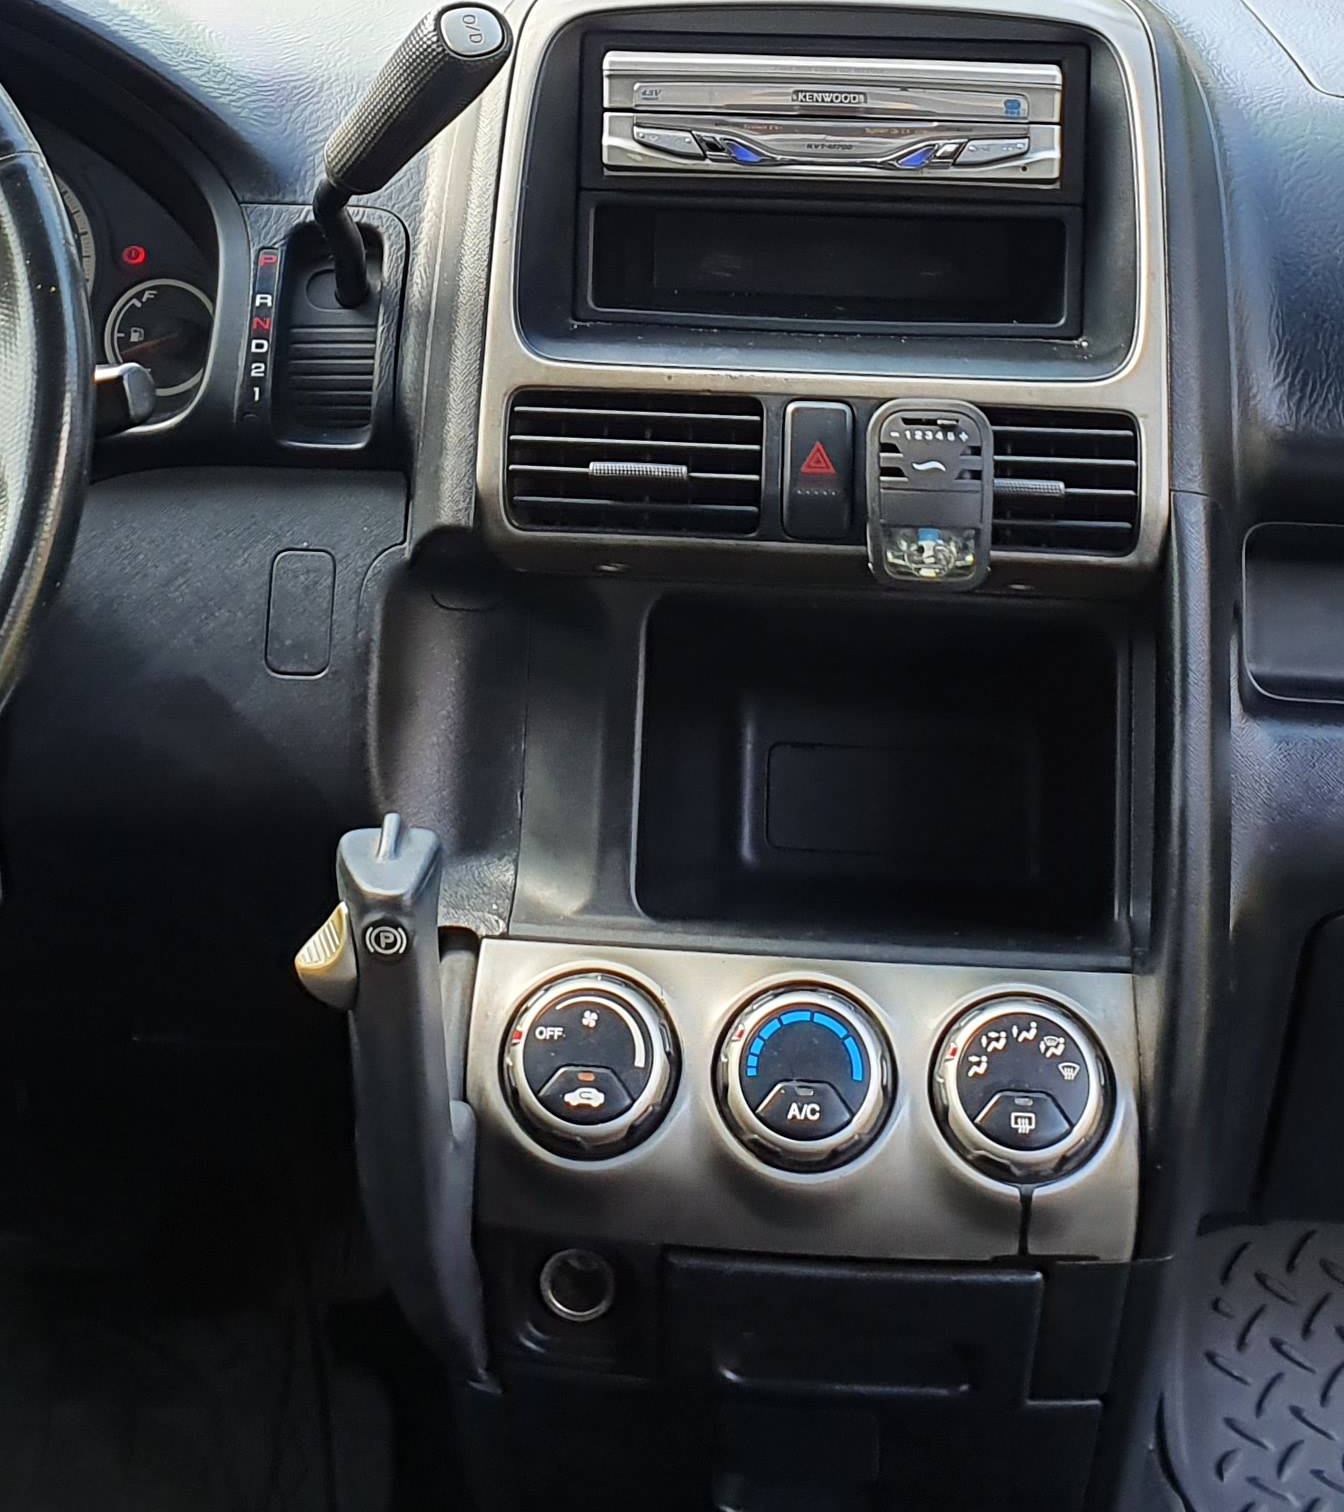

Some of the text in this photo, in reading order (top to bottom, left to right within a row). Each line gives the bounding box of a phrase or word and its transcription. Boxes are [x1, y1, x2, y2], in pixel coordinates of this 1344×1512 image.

[462, 14, 483, 44] O/D
[797, 92, 859, 104] KENWOOD
[258, 254, 277, 266] P
[142, 290, 158, 303] F
[255, 294, 272, 307] R
[252, 317, 272, 331] N
[250, 339, 269, 353] D
[250, 362, 265, 377] 2
[253, 387, 260, 401] 1
[535, 1027, 564, 1040] OFF
[787, 1104, 821, 1120] A/C
